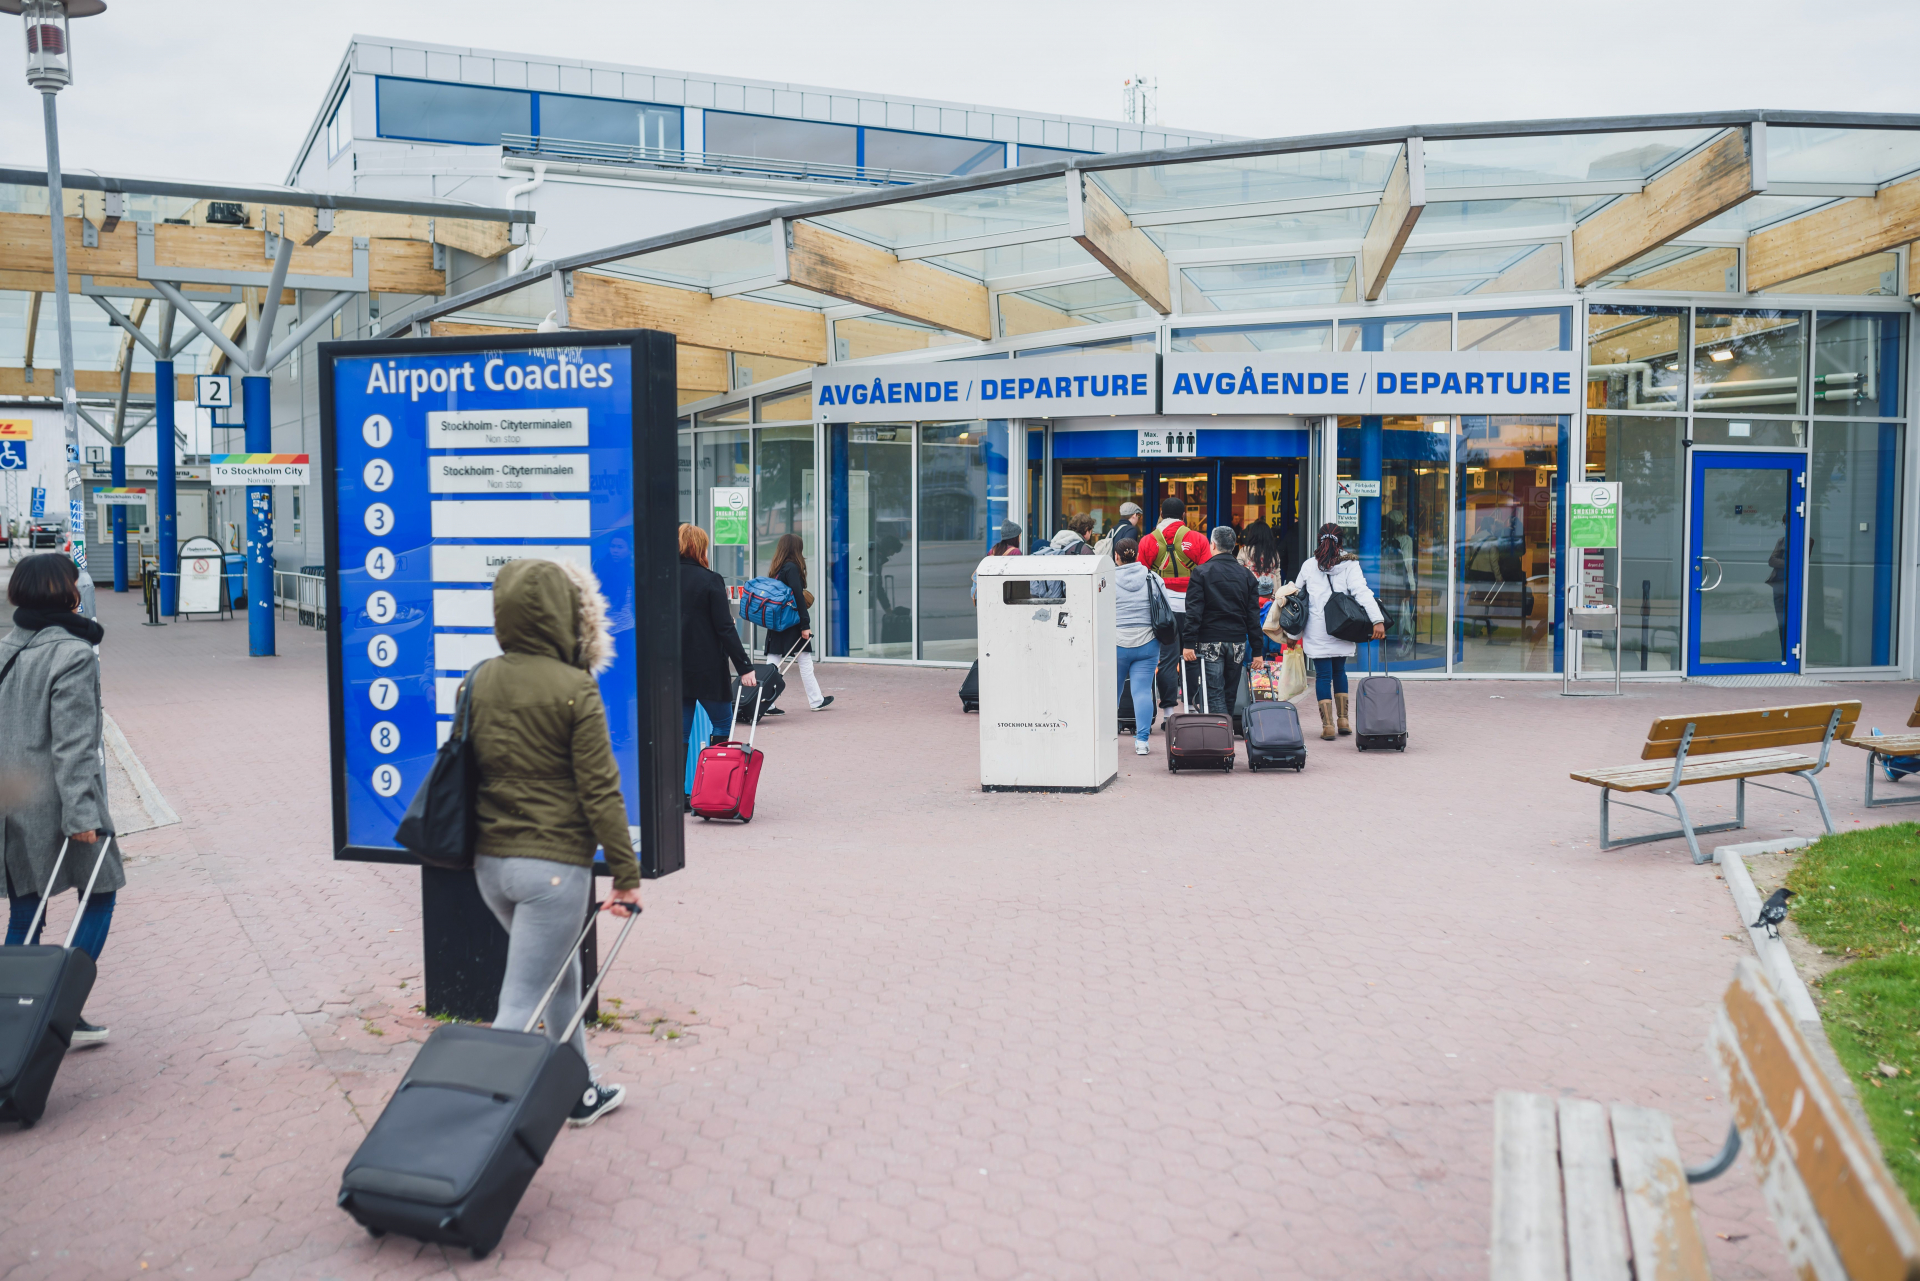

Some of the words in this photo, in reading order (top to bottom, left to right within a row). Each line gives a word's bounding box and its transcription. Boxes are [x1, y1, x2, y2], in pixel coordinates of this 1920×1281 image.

[366, 361, 475, 402] Airport
[484, 355, 613, 391] Coaches
[1172, 366, 1349, 395] AVGÅENDE
[1358, 372, 1367, 395] /
[1376, 371, 1571, 395] DEPARTURE
[209, 381, 222, 401] 2
[818, 377, 958, 406] AVGÅENDE
[966, 380, 973, 402] /
[980, 373, 1148, 401] DEPARTURE
[373, 421, 381, 442] 1
[441, 420, 493, 431] Stockholm
[500, 419, 572, 432] Cityterminalen
[485, 434, 501, 443] Non
[504, 434, 521, 444] stop
[1146, 439, 1162, 447] pers.
[92, 449, 98, 460] 1
[215, 467, 228, 475] To
[230, 466, 282, 475] Stockholm
[284, 466, 303, 477] City
[262, 477, 276, 485] stop
[374, 465, 384, 486] 2
[443, 465, 494, 476] Stockholm
[502, 464, 574, 478] Cityterminalen
[1476, 475, 1482, 486] 6
[1538, 474, 1544, 485] 5
[36, 489, 44, 499] P
[487, 479, 503, 488] Non
[505, 479, 522, 490] stop
[374, 509, 385, 530] 3
[373, 553, 386, 573] 4
[376, 597, 387, 618] 5
[377, 641, 388, 661] 6
[378, 684, 389, 704] 7
[380, 727, 391, 747] 8
[381, 771, 392, 791] 9
